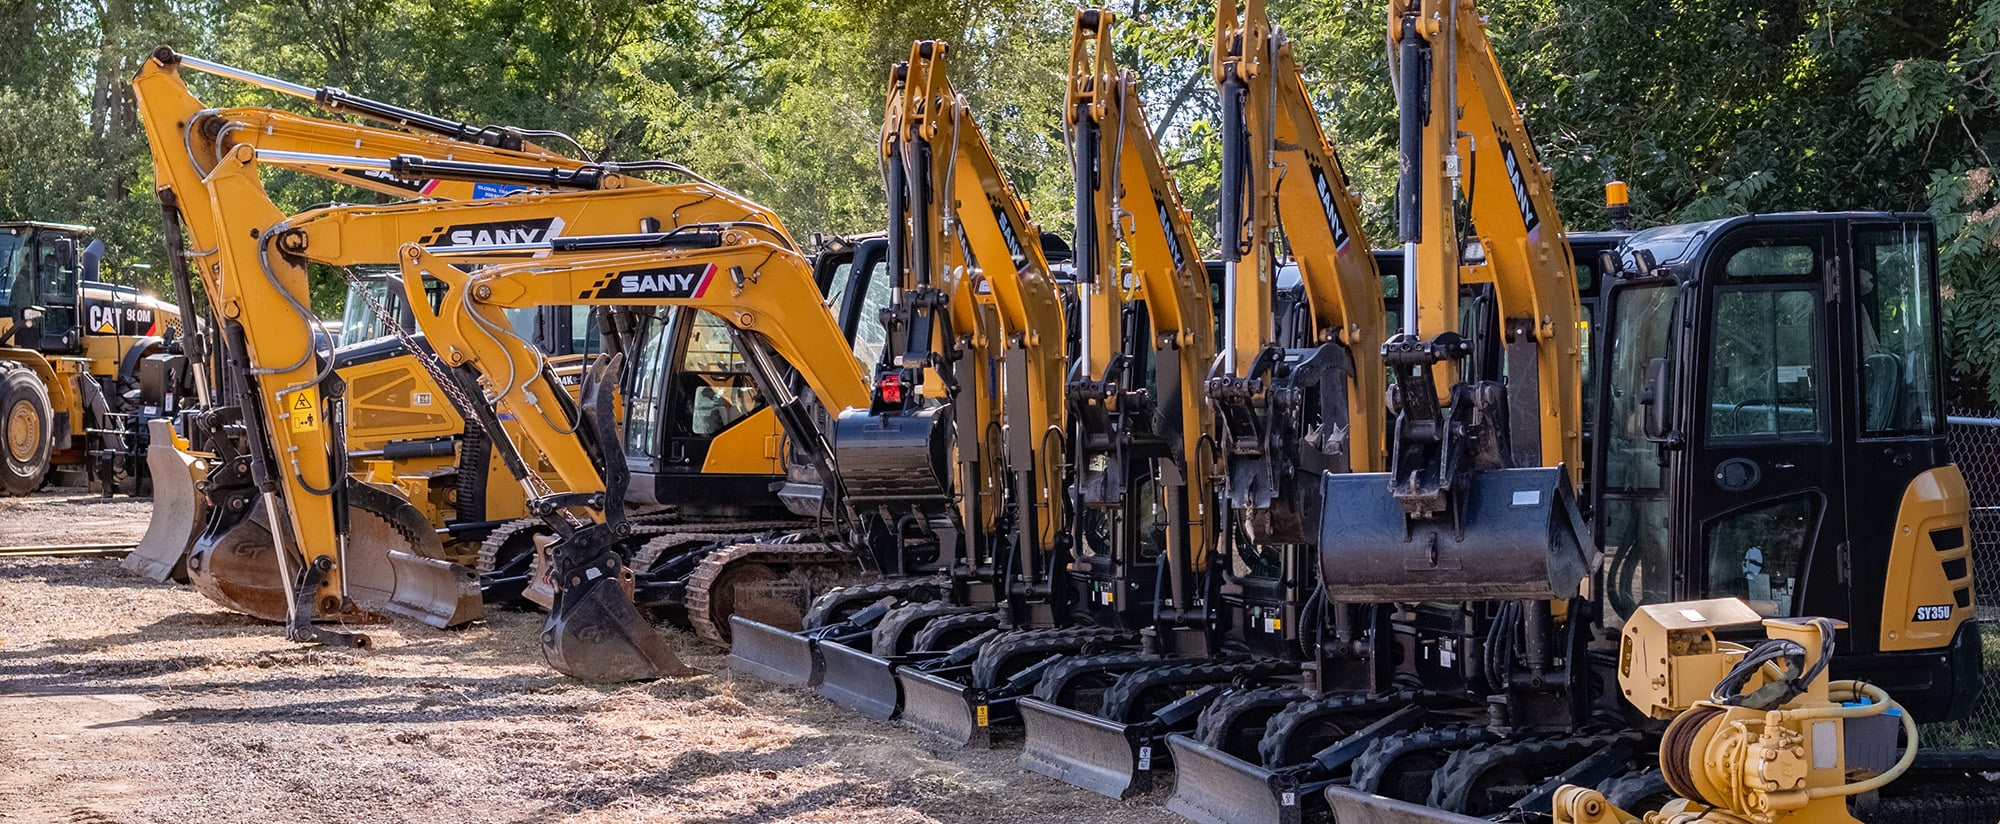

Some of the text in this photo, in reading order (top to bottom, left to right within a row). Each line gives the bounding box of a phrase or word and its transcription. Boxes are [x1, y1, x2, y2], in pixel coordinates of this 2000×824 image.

[1506, 150, 1533, 225] SANY
[1318, 174, 1343, 240] SANY
[451, 228, 540, 246] SANY
[621, 273, 695, 293] SANY
[89, 305, 122, 334] CAT
[1917, 606, 1950, 620] SY35U
